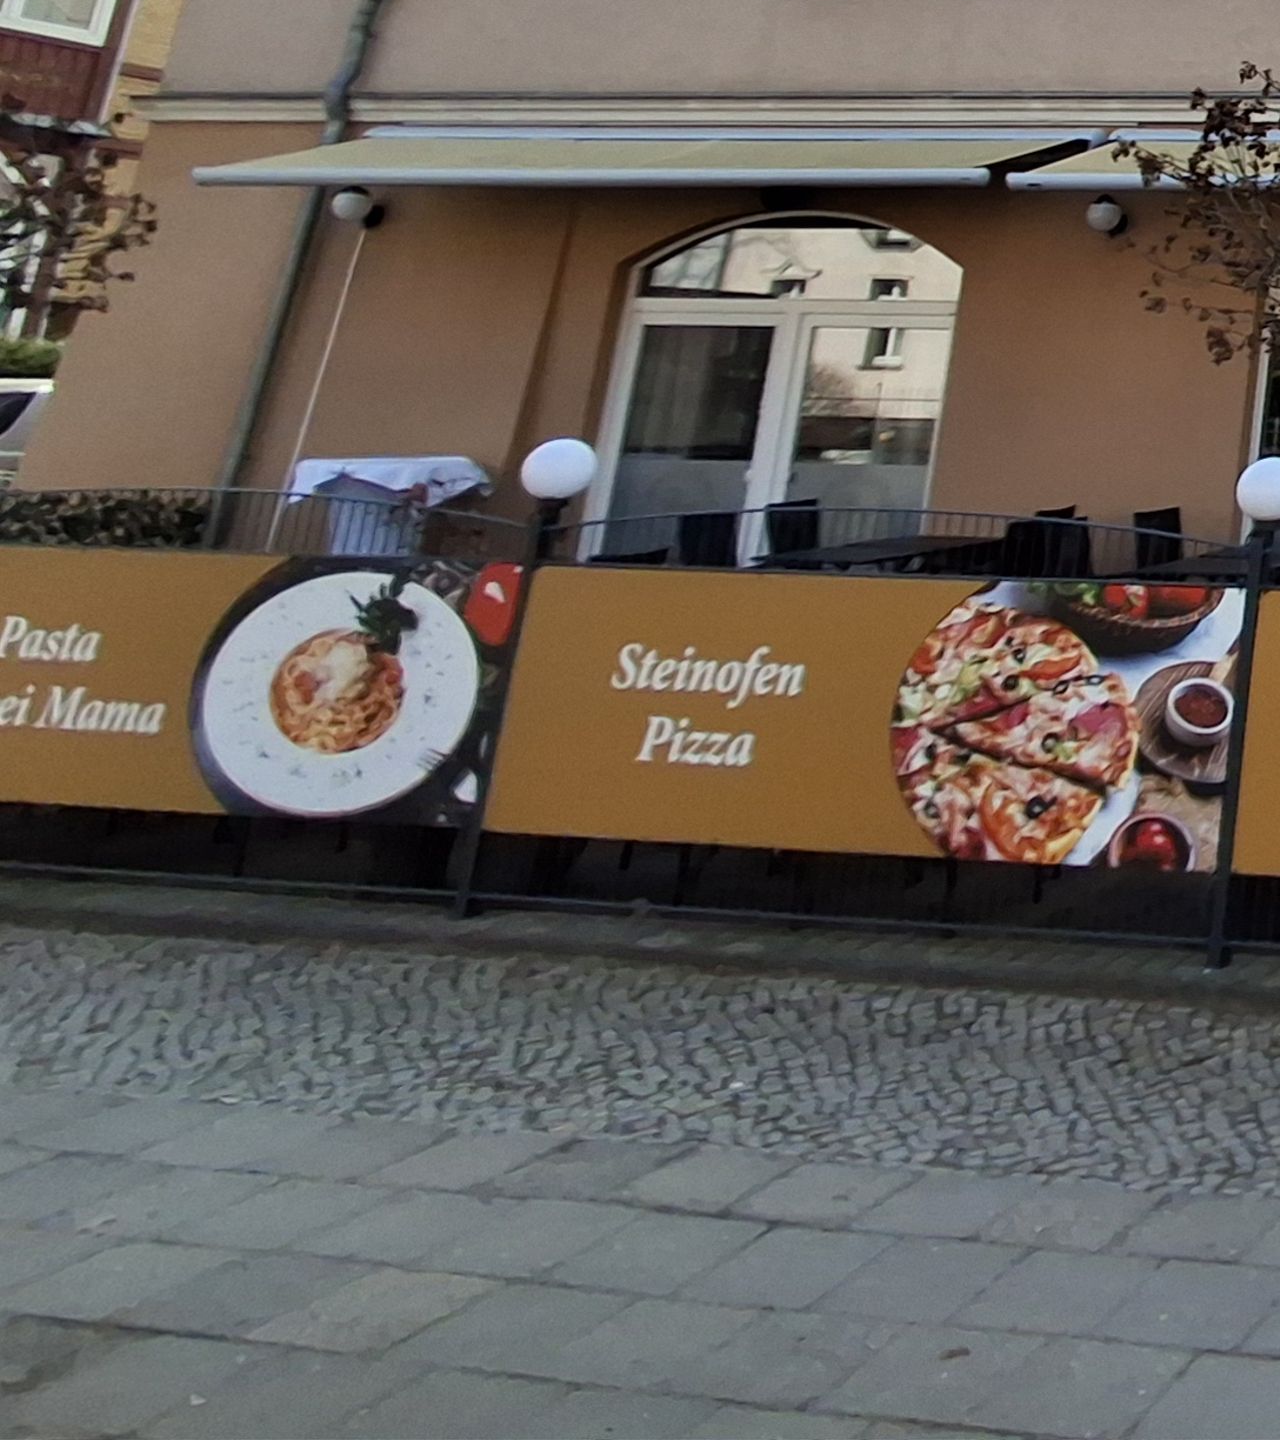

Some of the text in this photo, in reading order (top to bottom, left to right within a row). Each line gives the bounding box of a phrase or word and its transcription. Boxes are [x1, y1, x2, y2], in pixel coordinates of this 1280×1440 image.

[0, 614, 102, 663] Pasta
[610, 642, 807, 710] Steinofen
[33, 684, 166, 735] Mama
[635, 714, 757, 768] Pizza
